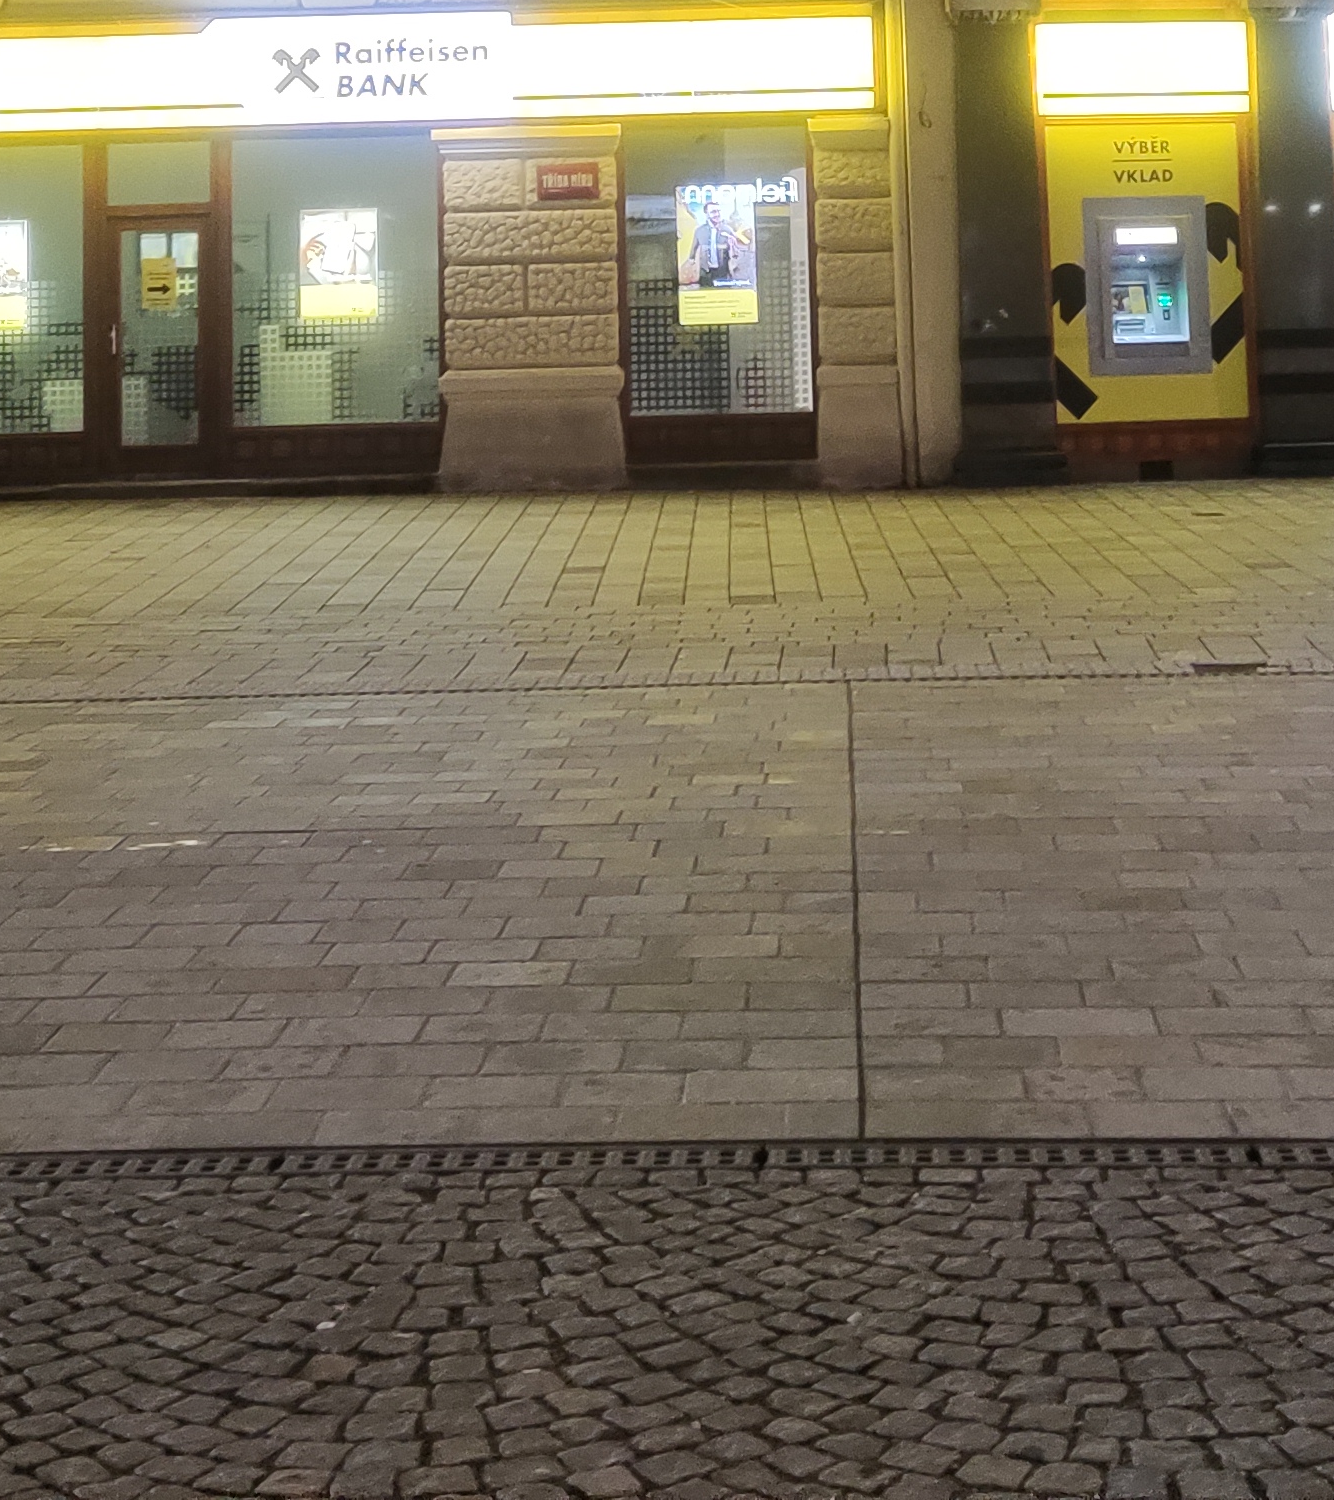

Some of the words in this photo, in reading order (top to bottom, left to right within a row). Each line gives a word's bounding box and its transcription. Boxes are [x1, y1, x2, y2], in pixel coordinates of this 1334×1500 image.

[334, 38, 488, 64] Raiffeisen
[336, 72, 429, 98] BANK
[1113, 135, 1171, 155] VÝBĚR
[1113, 169, 1174, 184] VKLAD
